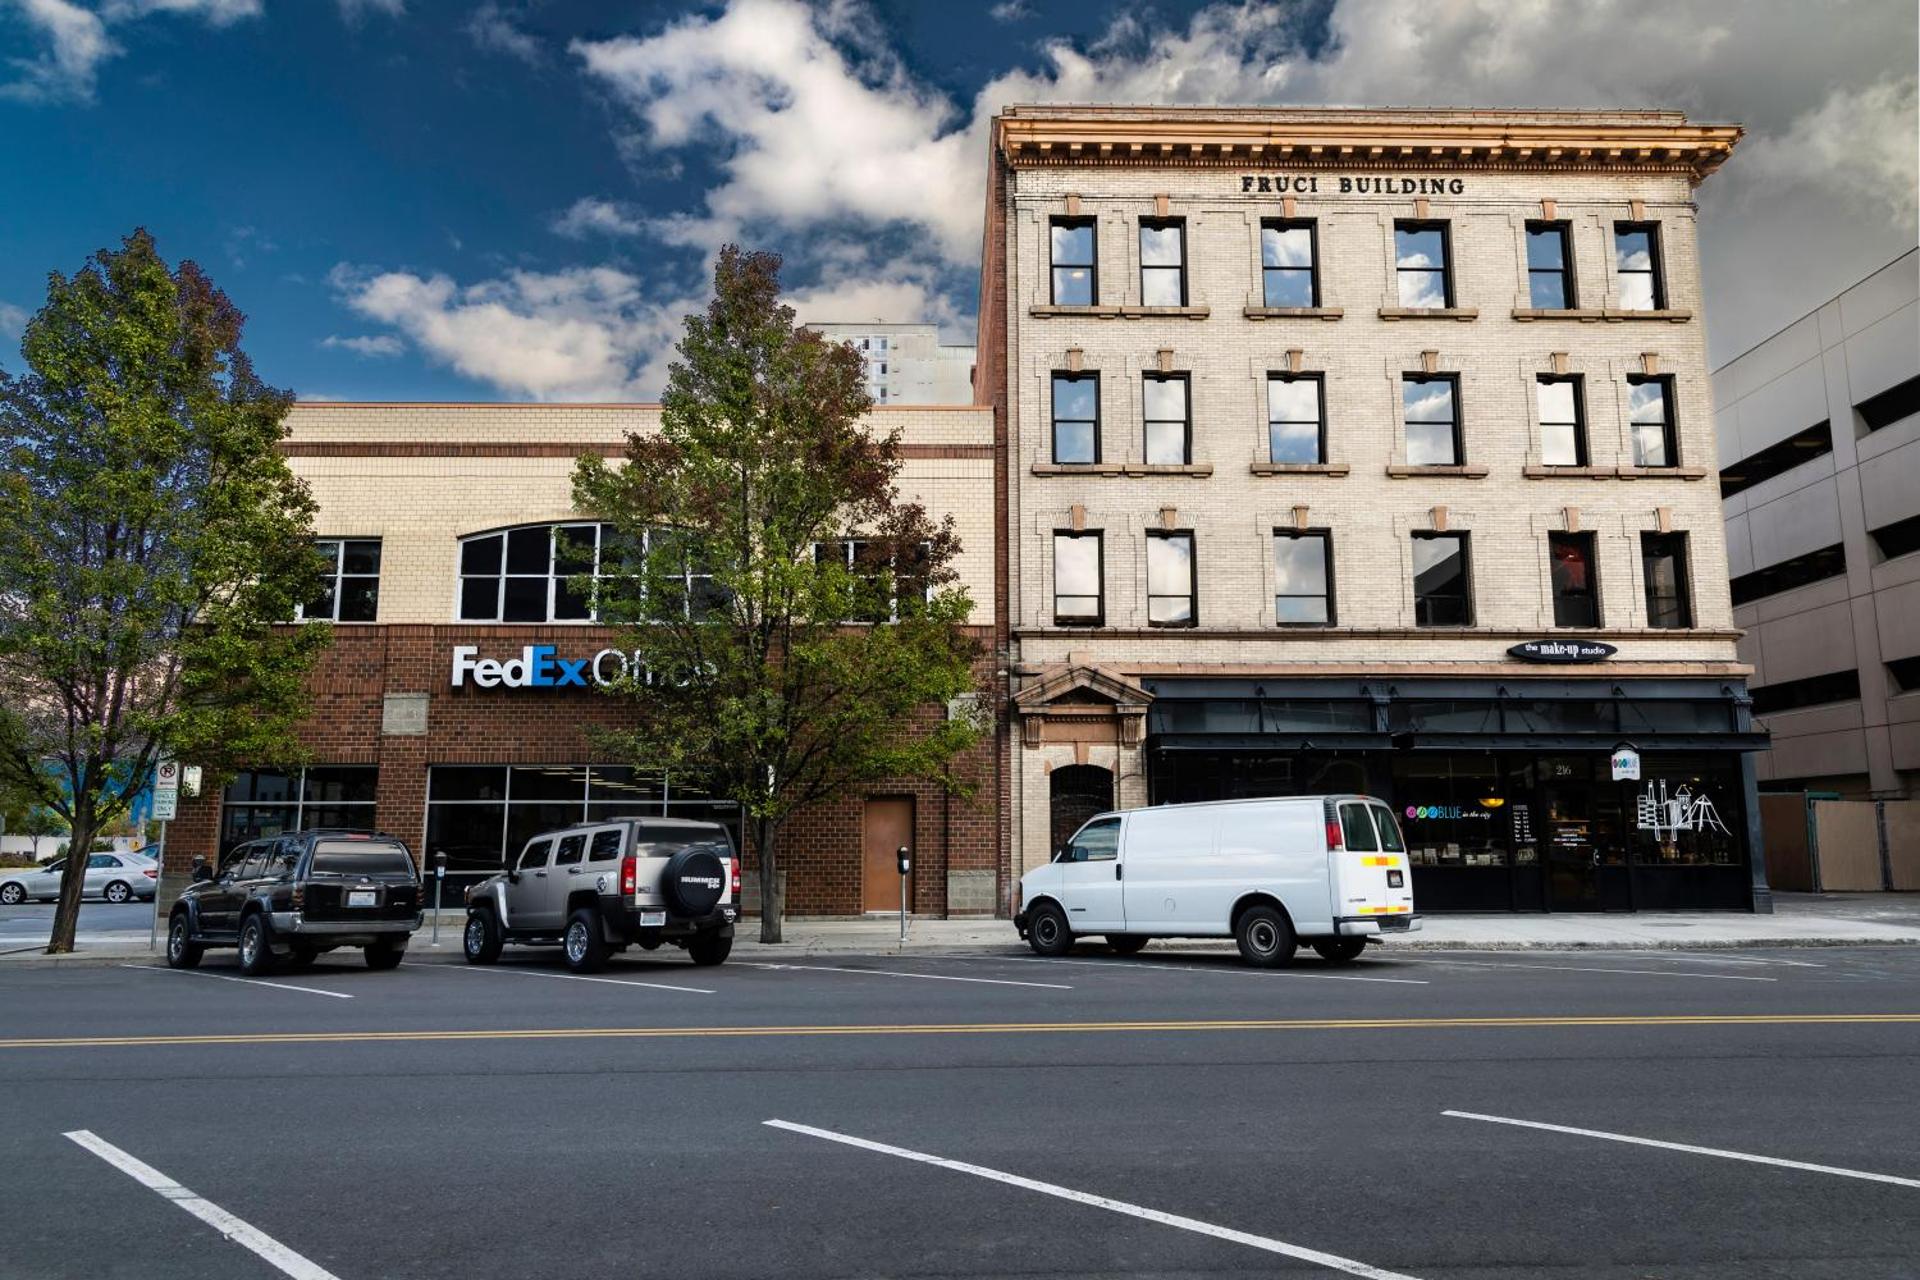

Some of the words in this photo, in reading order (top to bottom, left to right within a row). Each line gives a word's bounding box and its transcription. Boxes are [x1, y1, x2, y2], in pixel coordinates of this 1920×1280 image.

[1241, 176, 1318, 193] FRUCI
[1339, 177, 1465, 195] BUILDING
[1525, 643, 1538, 651] the
[1540, 642, 1579, 658] make-up
[1581, 646, 1606, 655] studio
[451, 645, 588, 688] FedEx
[680, 876, 720, 884] HUMMER
